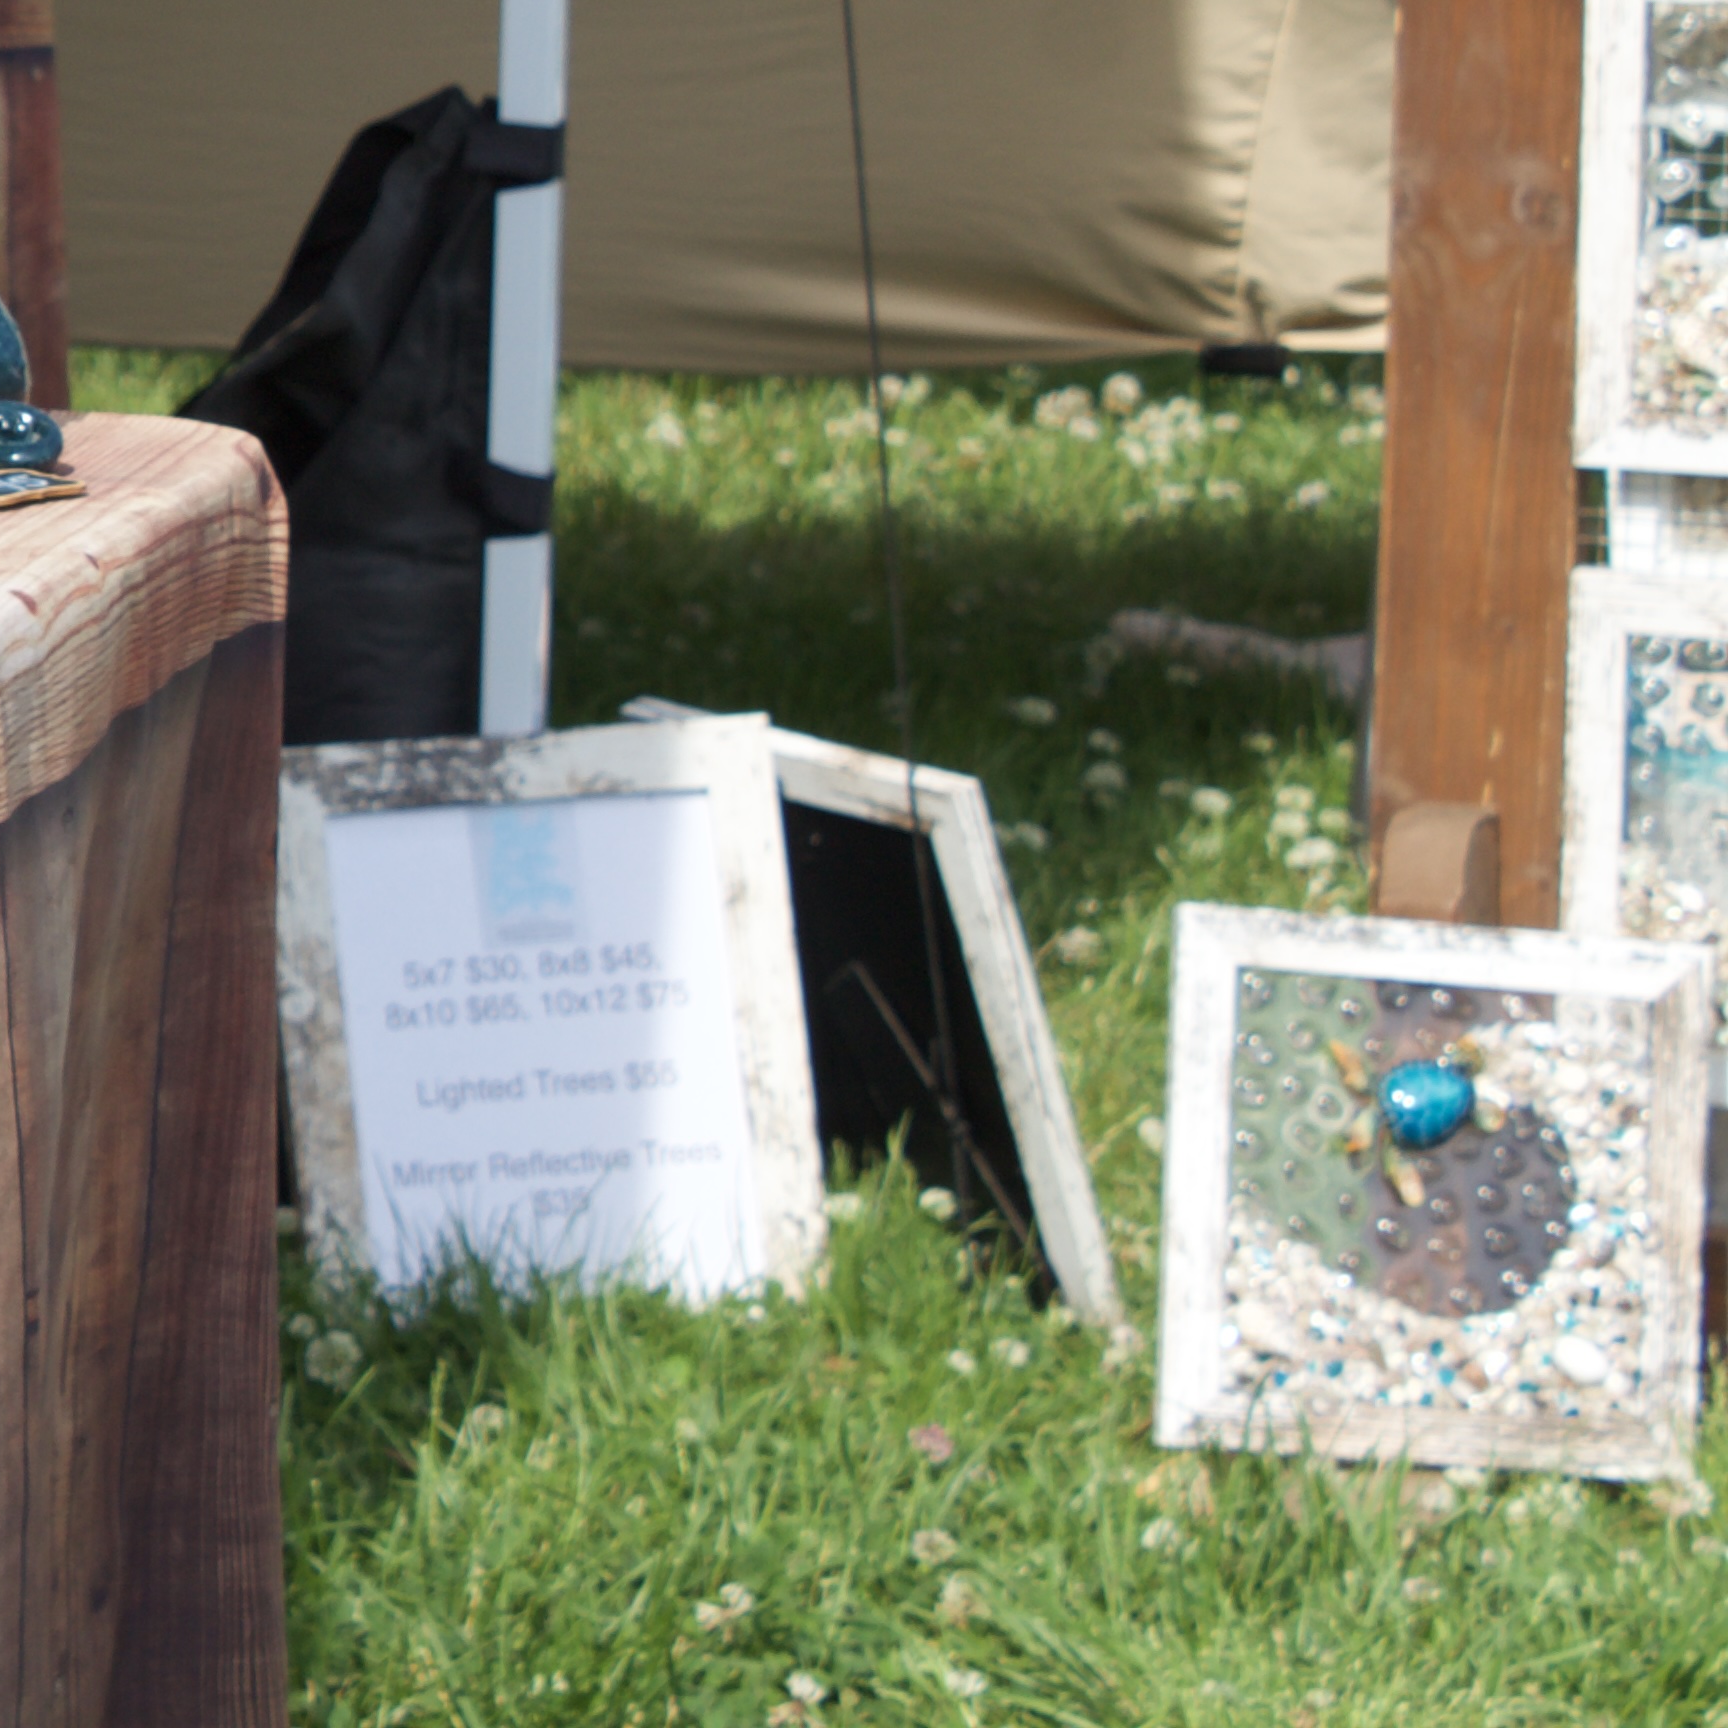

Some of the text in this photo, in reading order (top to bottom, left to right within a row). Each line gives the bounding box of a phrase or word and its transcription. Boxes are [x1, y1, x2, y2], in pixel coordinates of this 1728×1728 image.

[402, 957, 455, 990] 5x7
[537, 947, 593, 979] 8x8
[384, 997, 458, 1032] 8x10
[542, 984, 628, 1017] 10x12
[636, 977, 691, 1012] $75
[416, 1074, 525, 1113] Lighted
[534, 1068, 617, 1097] Trees
[392, 1137, 723, 1188] Mirror Reflective Trees
